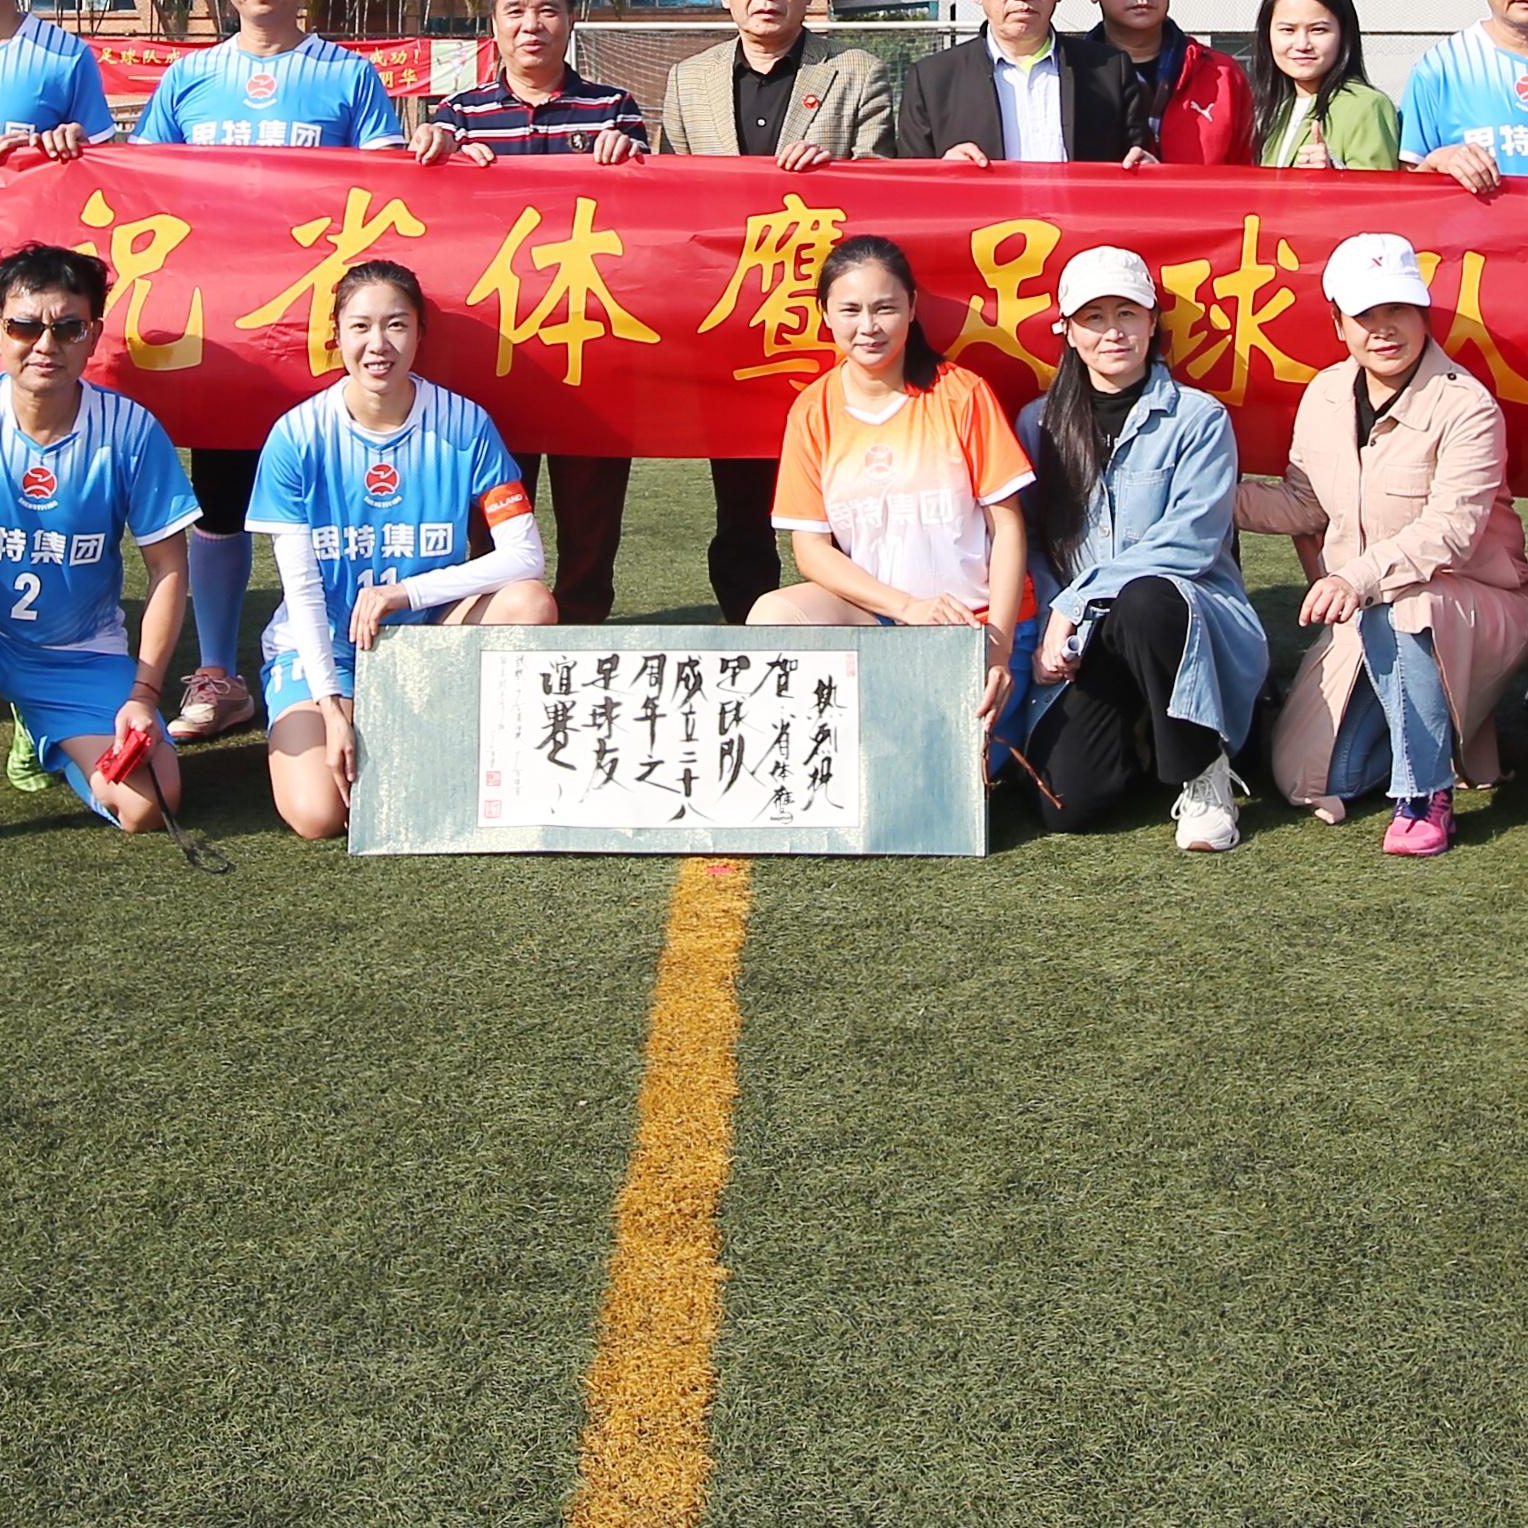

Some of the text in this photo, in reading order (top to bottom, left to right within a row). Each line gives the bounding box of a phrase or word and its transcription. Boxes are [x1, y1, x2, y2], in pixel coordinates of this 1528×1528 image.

[191, 119, 322, 147] 思特集团
[311, 522, 454, 561] 思特集团
[10, 572, 41, 621] 2
